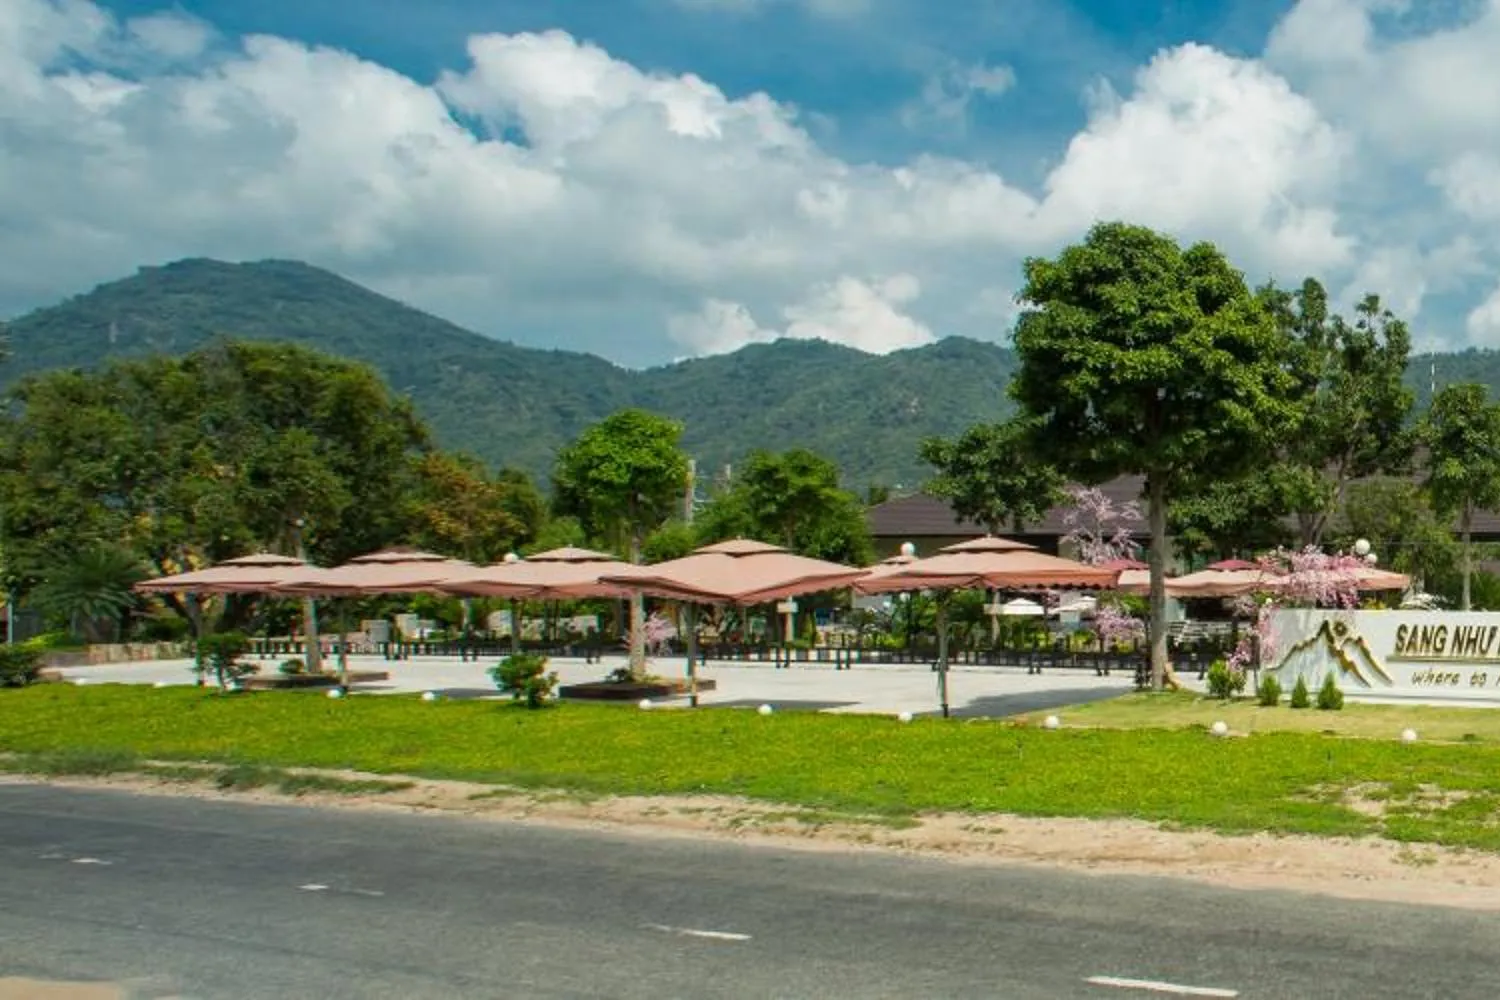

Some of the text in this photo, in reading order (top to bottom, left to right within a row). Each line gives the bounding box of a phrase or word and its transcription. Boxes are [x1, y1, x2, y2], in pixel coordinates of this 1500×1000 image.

[1394, 623, 1448, 653] SANG
[1411, 668, 1460, 686] where
[1469, 671, 1487, 687] to
